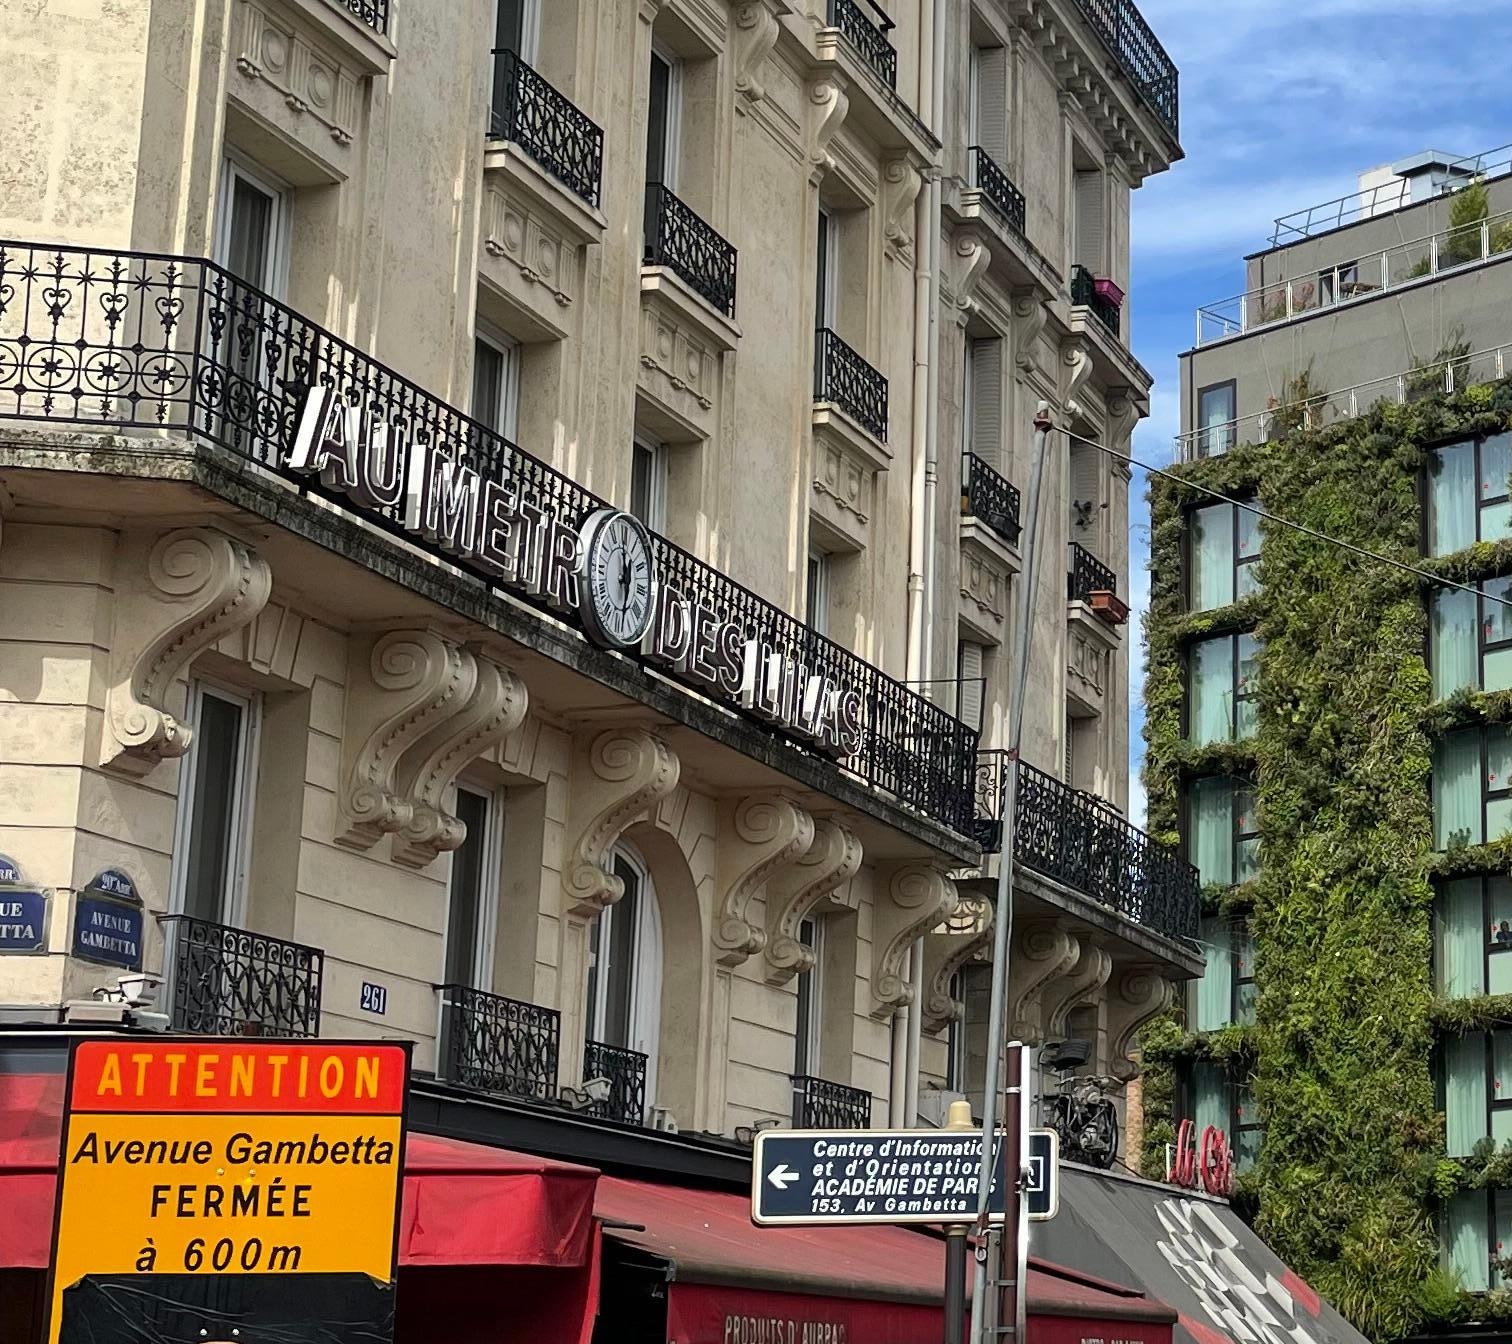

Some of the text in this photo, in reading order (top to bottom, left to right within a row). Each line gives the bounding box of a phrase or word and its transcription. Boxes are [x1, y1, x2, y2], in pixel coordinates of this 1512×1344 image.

[297, 387, 406, 507] AU
[650, 583, 746, 696] DES
[748, 640, 864, 757] LILAS
[91, 911, 131, 934] AVENUE
[80, 930, 137, 956] GAMBETTA
[362, 984, 385, 1013] 261
[97, 1053, 381, 1099] ATTENTION
[72, 1131, 394, 1165] Avenue Gambetta
[813, 1140, 873, 1158] Centre
[812, 1161, 834, 1177] et
[150, 1176, 313, 1219] FERMÉE
[811, 1176, 997, 1197] ACADÉMIE DE PARS
[811, 1197, 967, 1214] 153, Av Gambetta
[135, 1237, 302, 1273] à 600m
